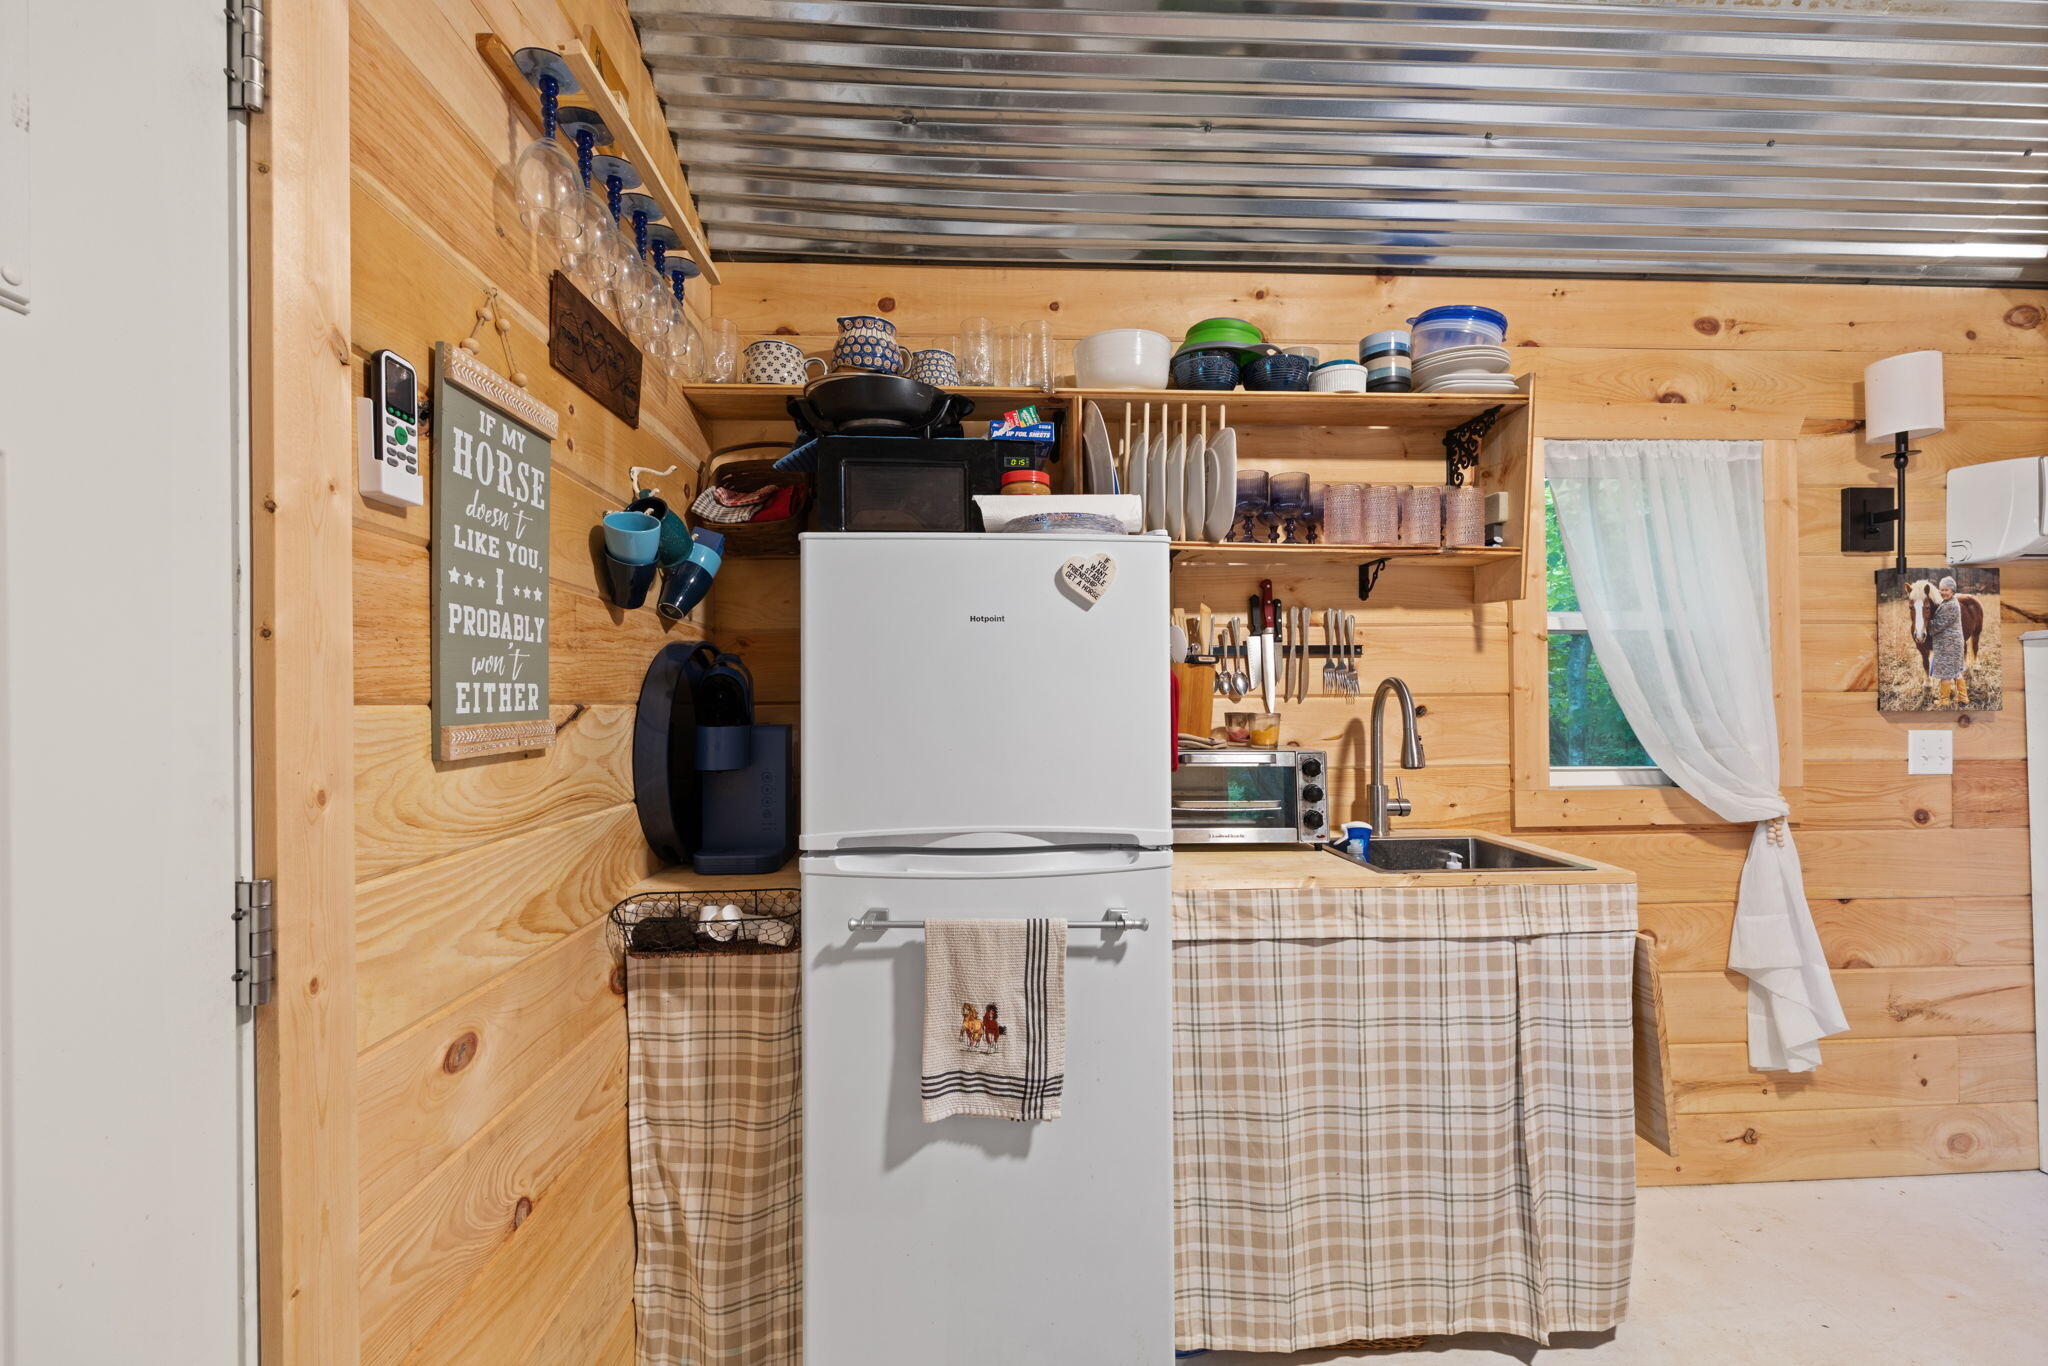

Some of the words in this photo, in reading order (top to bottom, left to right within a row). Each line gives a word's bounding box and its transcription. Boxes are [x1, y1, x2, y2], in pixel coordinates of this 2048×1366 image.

[479, 410, 496, 437] IF
[502, 423, 526, 454] MY
[452, 426, 545, 510] HORSE
[465, 488, 534, 540] doesn't
[453, 524, 500, 559] LIKE
[506, 540, 543, 574] YOU,
[1097, 560, 1108, 572] YOU
[495, 567, 504, 606] I
[1065, 570, 1077, 582] GET
[1082, 584, 1100, 600] HORSE
[1068, 564, 1098, 587] FRIENDSHIP
[1084, 568, 1106, 587] STABLE
[1090, 564, 1108, 578] WANT
[448, 602, 545, 643] PROBABLY
[969, 614, 1005, 624] Hotpoint
[471, 642, 530, 681] won't
[455, 681, 539, 714] EITHER
